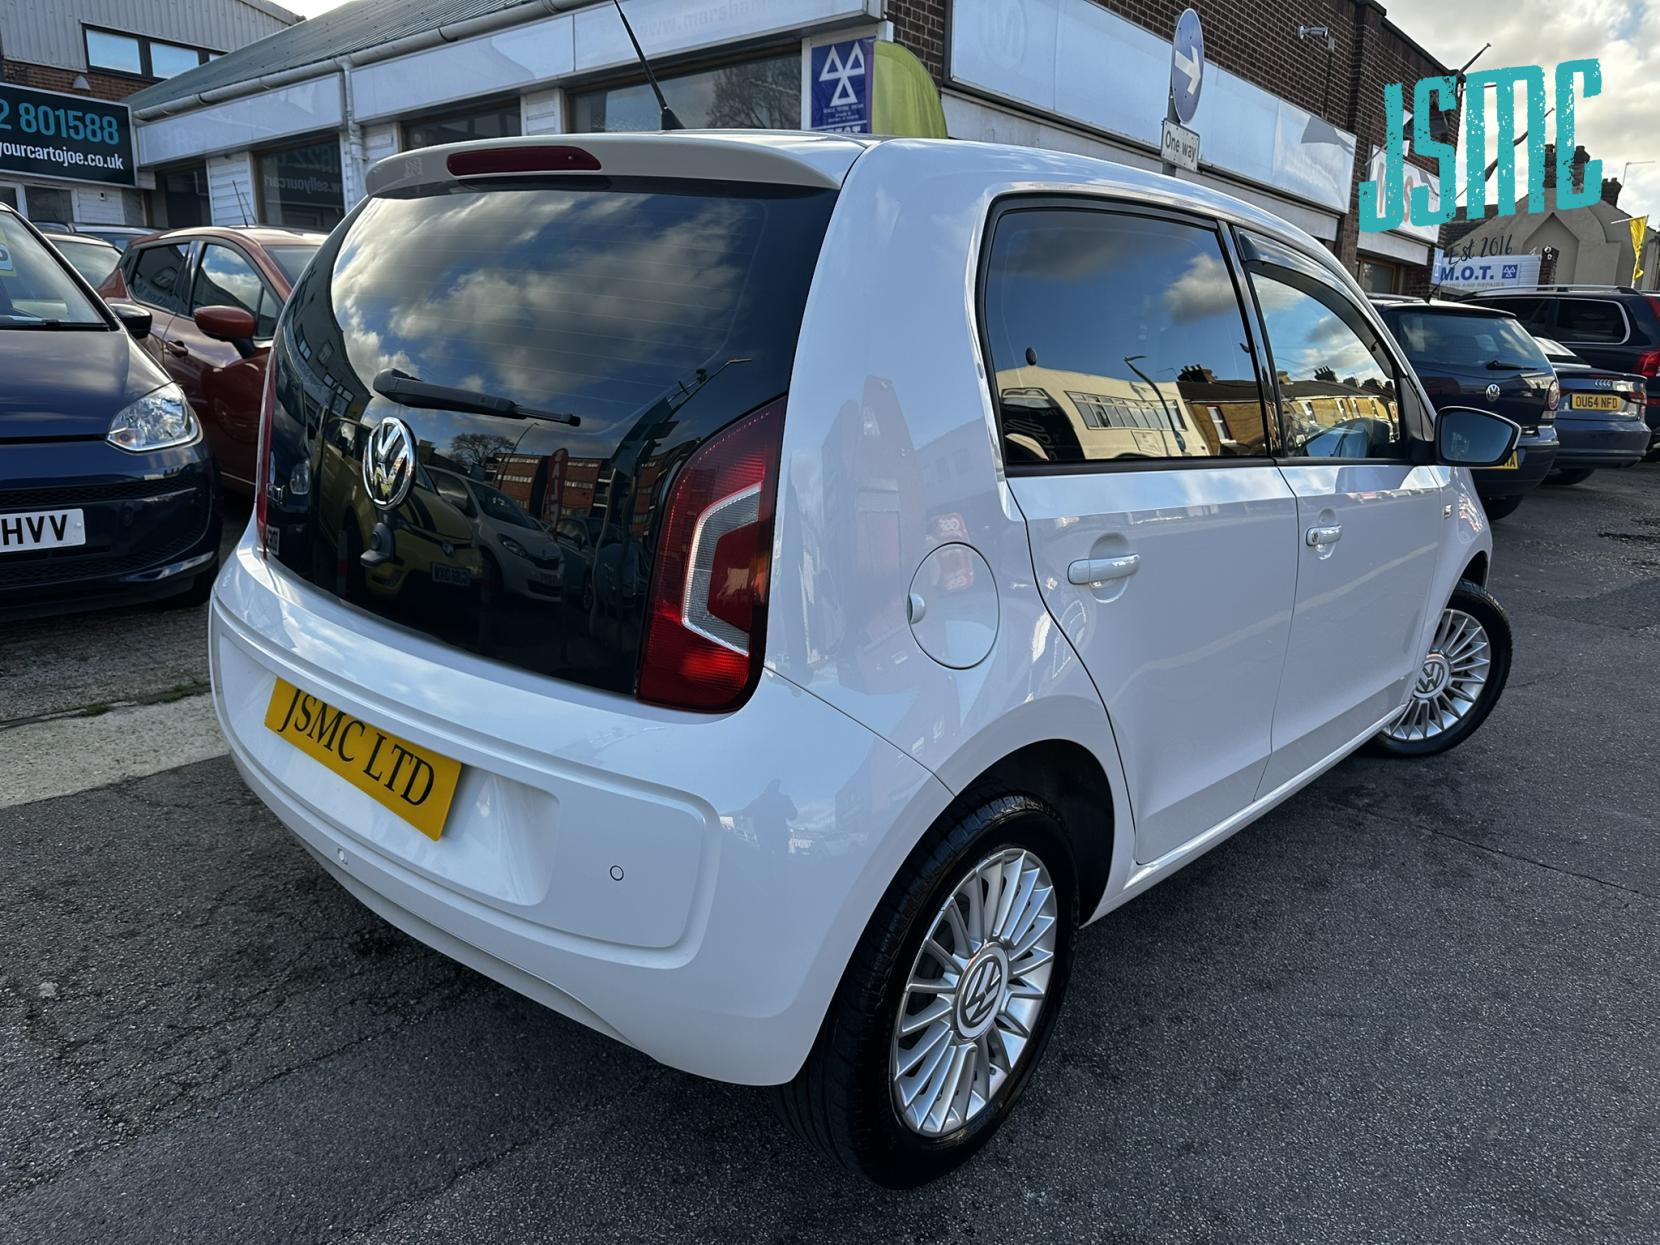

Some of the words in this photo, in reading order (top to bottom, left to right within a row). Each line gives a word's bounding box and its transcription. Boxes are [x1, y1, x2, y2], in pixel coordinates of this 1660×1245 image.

[18, 102, 119, 145] 801588
[0, 142, 124, 169] ourcartojoe.co.uk
[1165, 130, 1180, 153] One
[1181, 142, 1197, 163] way
[1441, 265, 1494, 281] M.O.T.
[1, 514, 67, 546] HVV
[277, 688, 366, 762] JSMC
[363, 732, 435, 806] LTD
